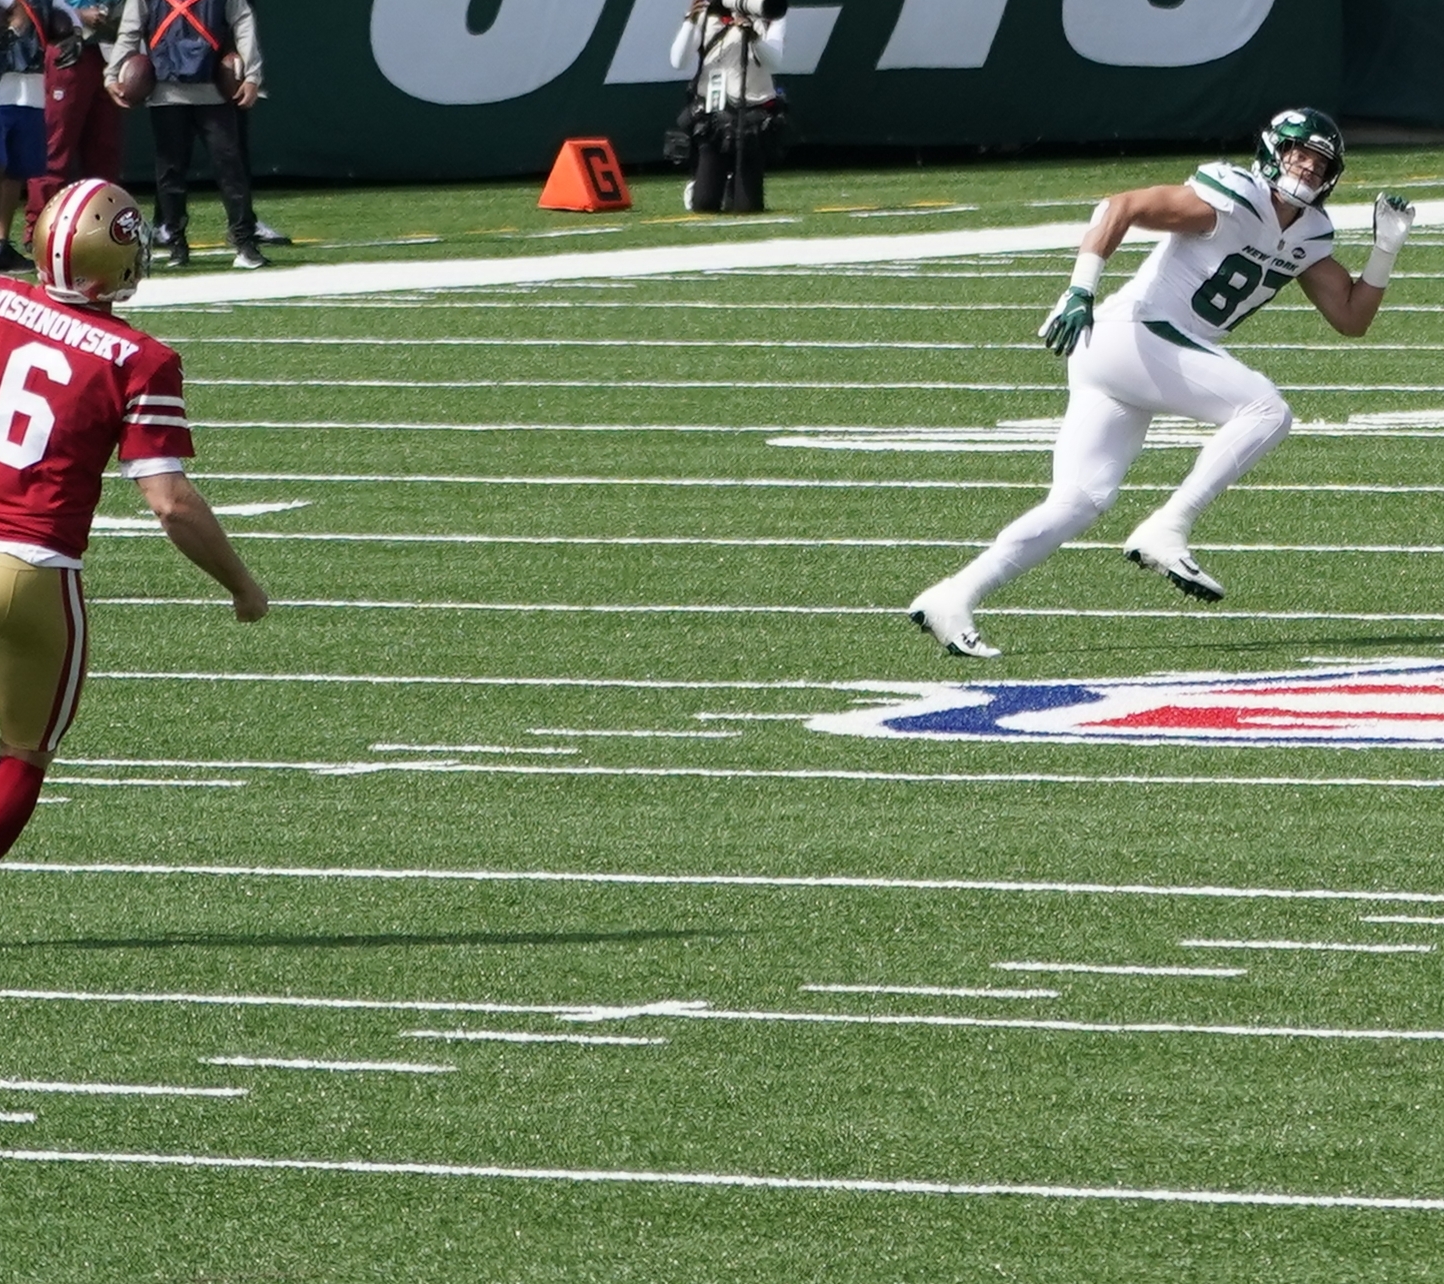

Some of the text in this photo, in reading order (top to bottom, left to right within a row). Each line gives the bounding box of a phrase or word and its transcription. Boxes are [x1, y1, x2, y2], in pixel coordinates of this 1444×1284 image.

[581, 145, 623, 202] G
[1242, 244, 1271, 262] NEW
[1191, 252, 1295, 332] 87
